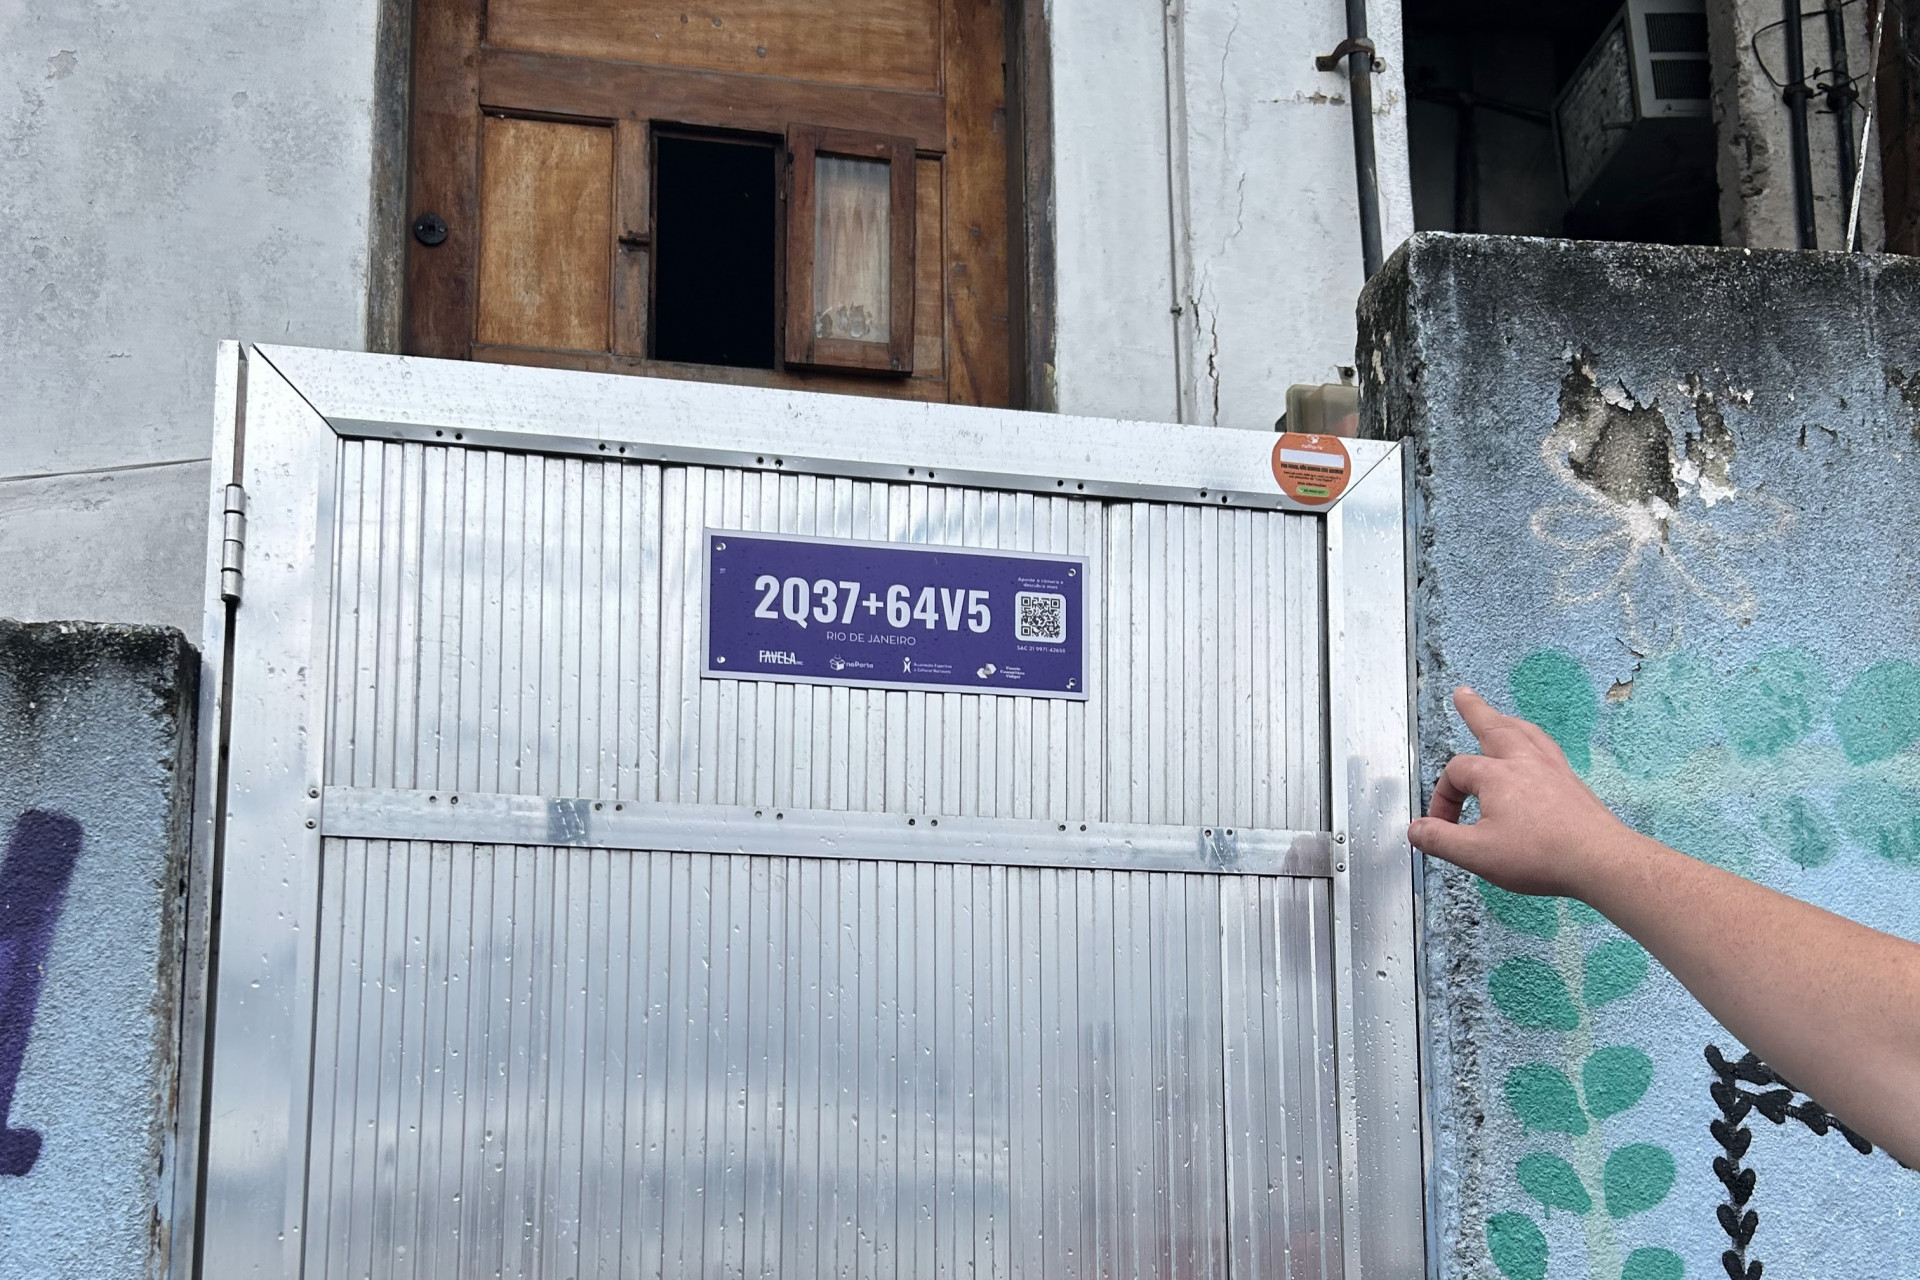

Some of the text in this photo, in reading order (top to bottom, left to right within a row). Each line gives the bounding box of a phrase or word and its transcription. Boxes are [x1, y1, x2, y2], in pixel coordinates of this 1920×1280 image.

[753, 574, 992, 634] 2Q37+64V5
[826, 630, 917, 646] RIO DE JANEIRO
[759, 650, 796, 664] FAVELA
